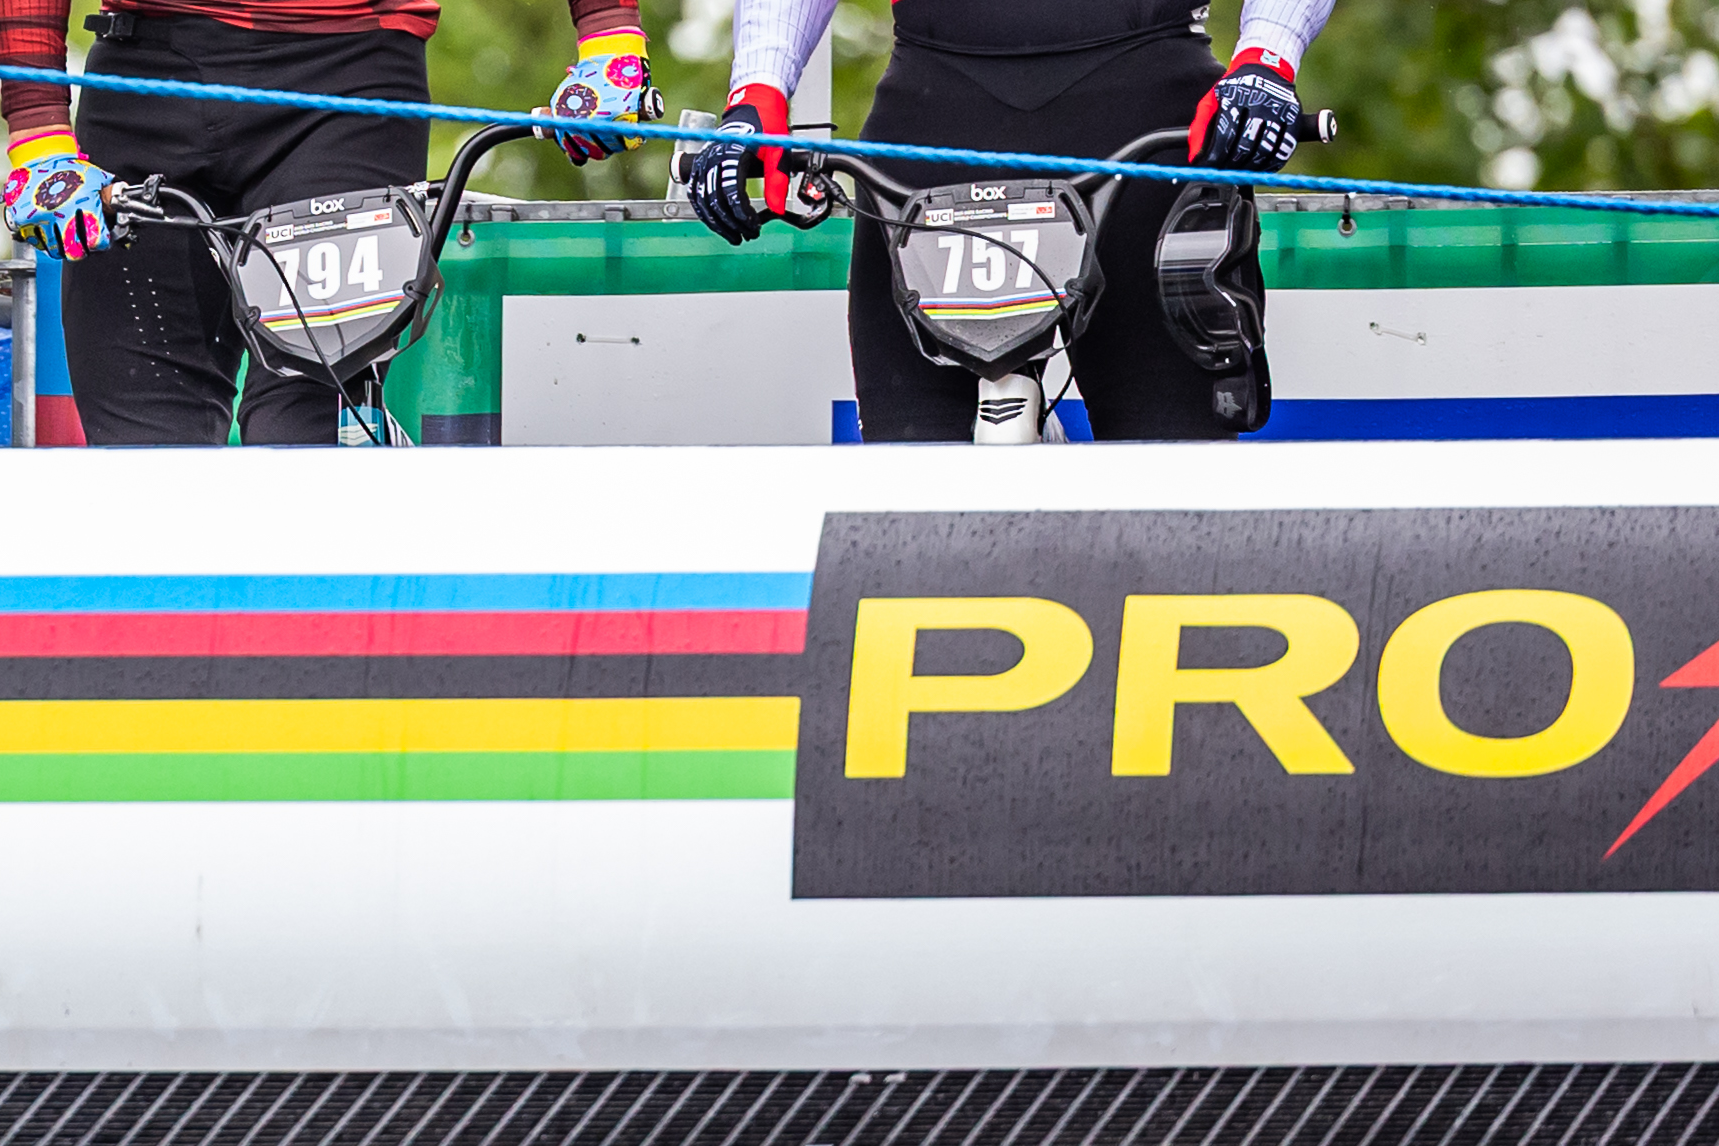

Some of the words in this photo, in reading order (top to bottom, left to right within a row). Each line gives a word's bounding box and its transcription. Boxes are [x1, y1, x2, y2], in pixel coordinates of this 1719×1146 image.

[970, 183, 1007, 202] box
[310, 198, 345, 215] box
[931, 212, 952, 223] UCI
[271, 228, 292, 239] UCI
[273, 235, 383, 306] 794
[938, 229, 1039, 294] 757
[844, 589, 1635, 779] PRO
